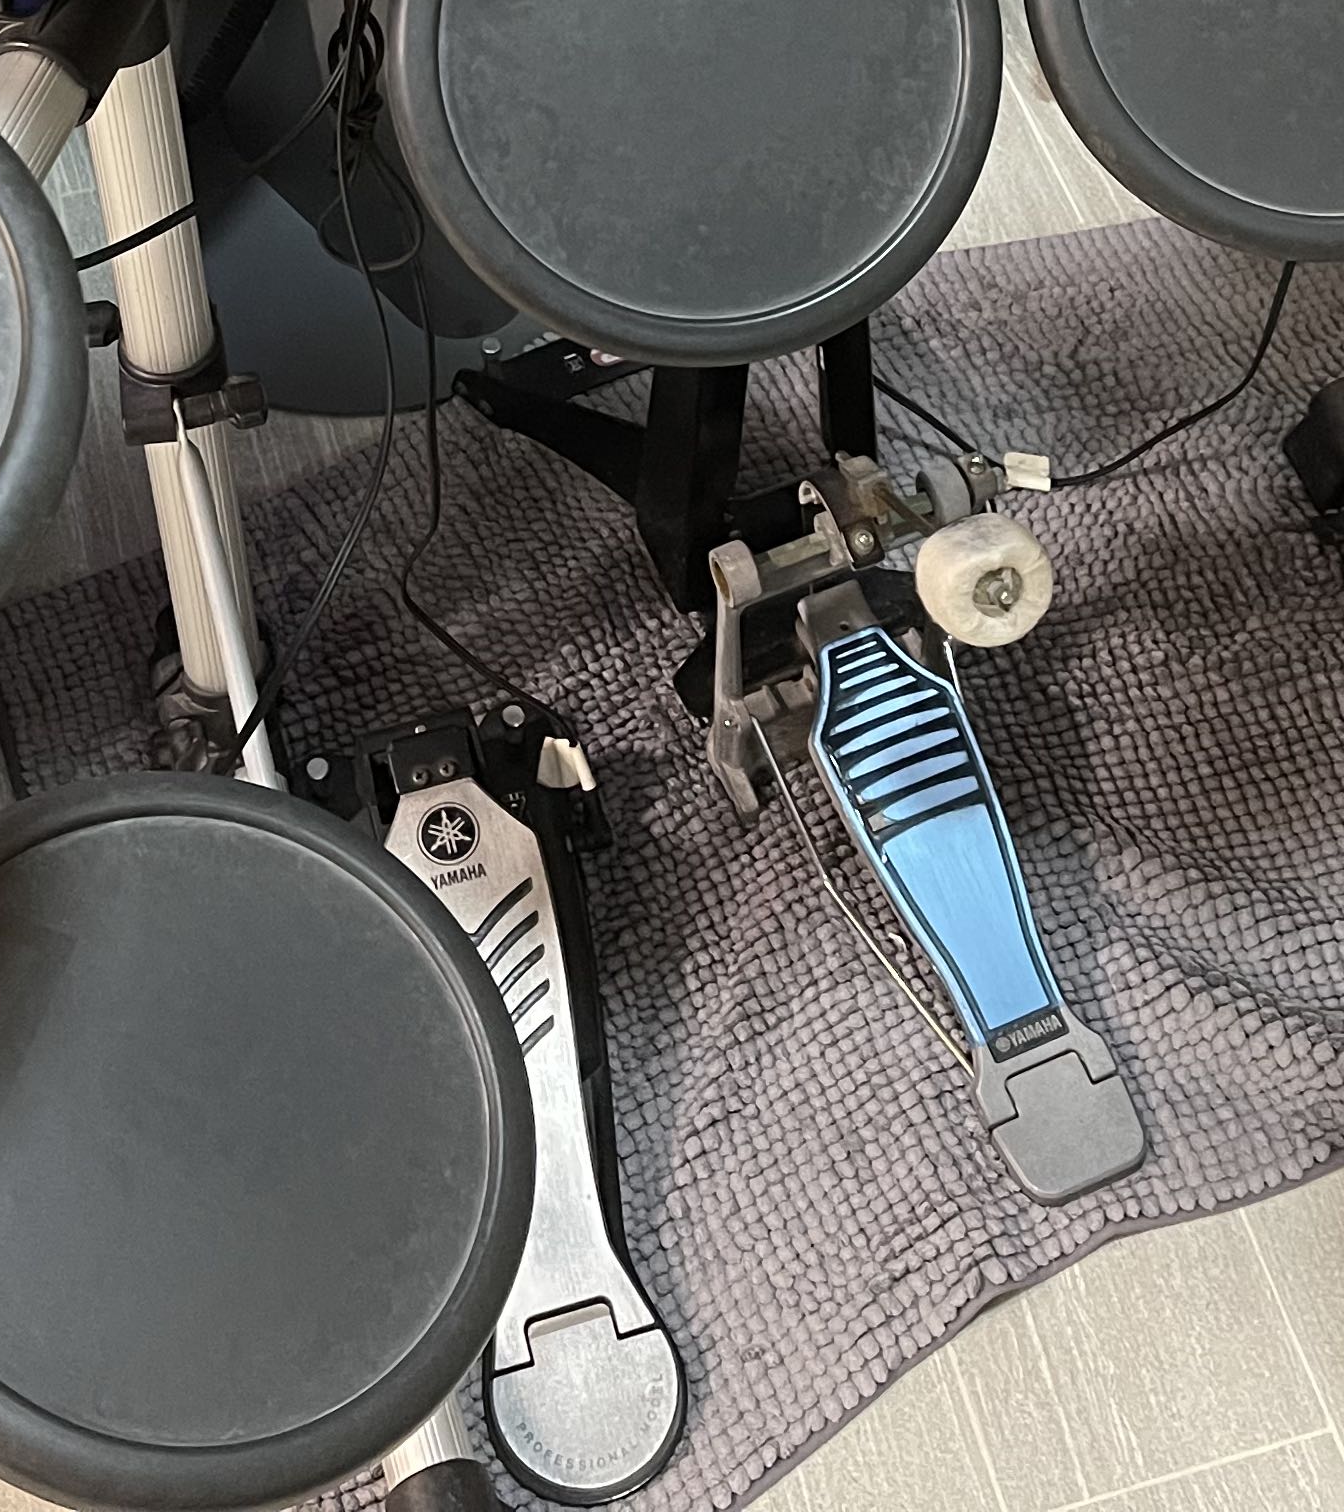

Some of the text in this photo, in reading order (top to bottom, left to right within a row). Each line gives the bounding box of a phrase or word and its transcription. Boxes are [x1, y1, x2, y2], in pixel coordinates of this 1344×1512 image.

[431, 863, 487, 890] YAMAHA
[1008, 1014, 1063, 1047] YAMAHA
[515, 1373, 663, 1472] PROFESSIONAL MODEL
